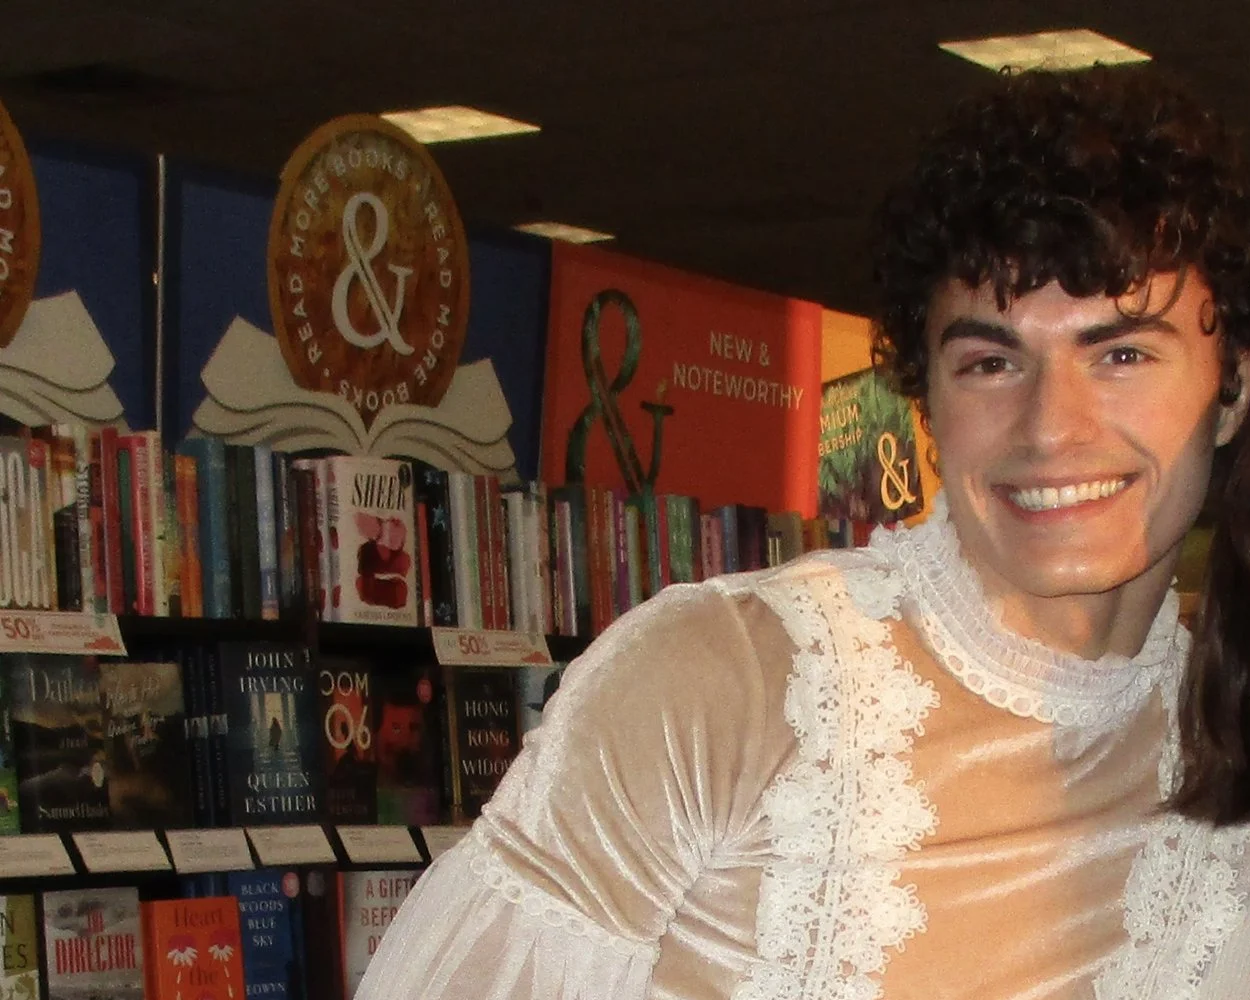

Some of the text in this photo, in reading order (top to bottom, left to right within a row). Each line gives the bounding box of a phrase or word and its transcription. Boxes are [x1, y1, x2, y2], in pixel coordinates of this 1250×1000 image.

[289, 147, 406, 364] READ MORE BOOKS
[338, 199, 453, 411] READ MORE BOOKS
[709, 329, 771, 367] NEW &
[672, 360, 804, 411] NOTEWORTHY
[820, 403, 860, 434] MIUM
[818, 427, 863, 456] BERSHIP
[352, 473, 405, 510] SHEER
[246, 651, 294, 670] JOHN
[240, 676, 304, 693] IRVING
[465, 701, 509, 718] HONG
[325, 704, 372, 750] 06
[467, 729, 510, 747] KONG
[247, 772, 312, 792] QUEEN
[245, 795, 317, 813] ESTHER
[241, 881, 280, 896] BLACK
[366, 879, 412, 898] A GIFT
[240, 900, 284, 914] WOODS
[174, 907, 224, 928] Heart
[248, 918, 277, 931] BLUE
[252, 935, 275, 948] SKY
[3, 943, 28, 970] ES
[56, 933, 136, 975] DIRECTOR
[189, 967, 218, 986] the
[246, 982, 287, 996] EOWYN
